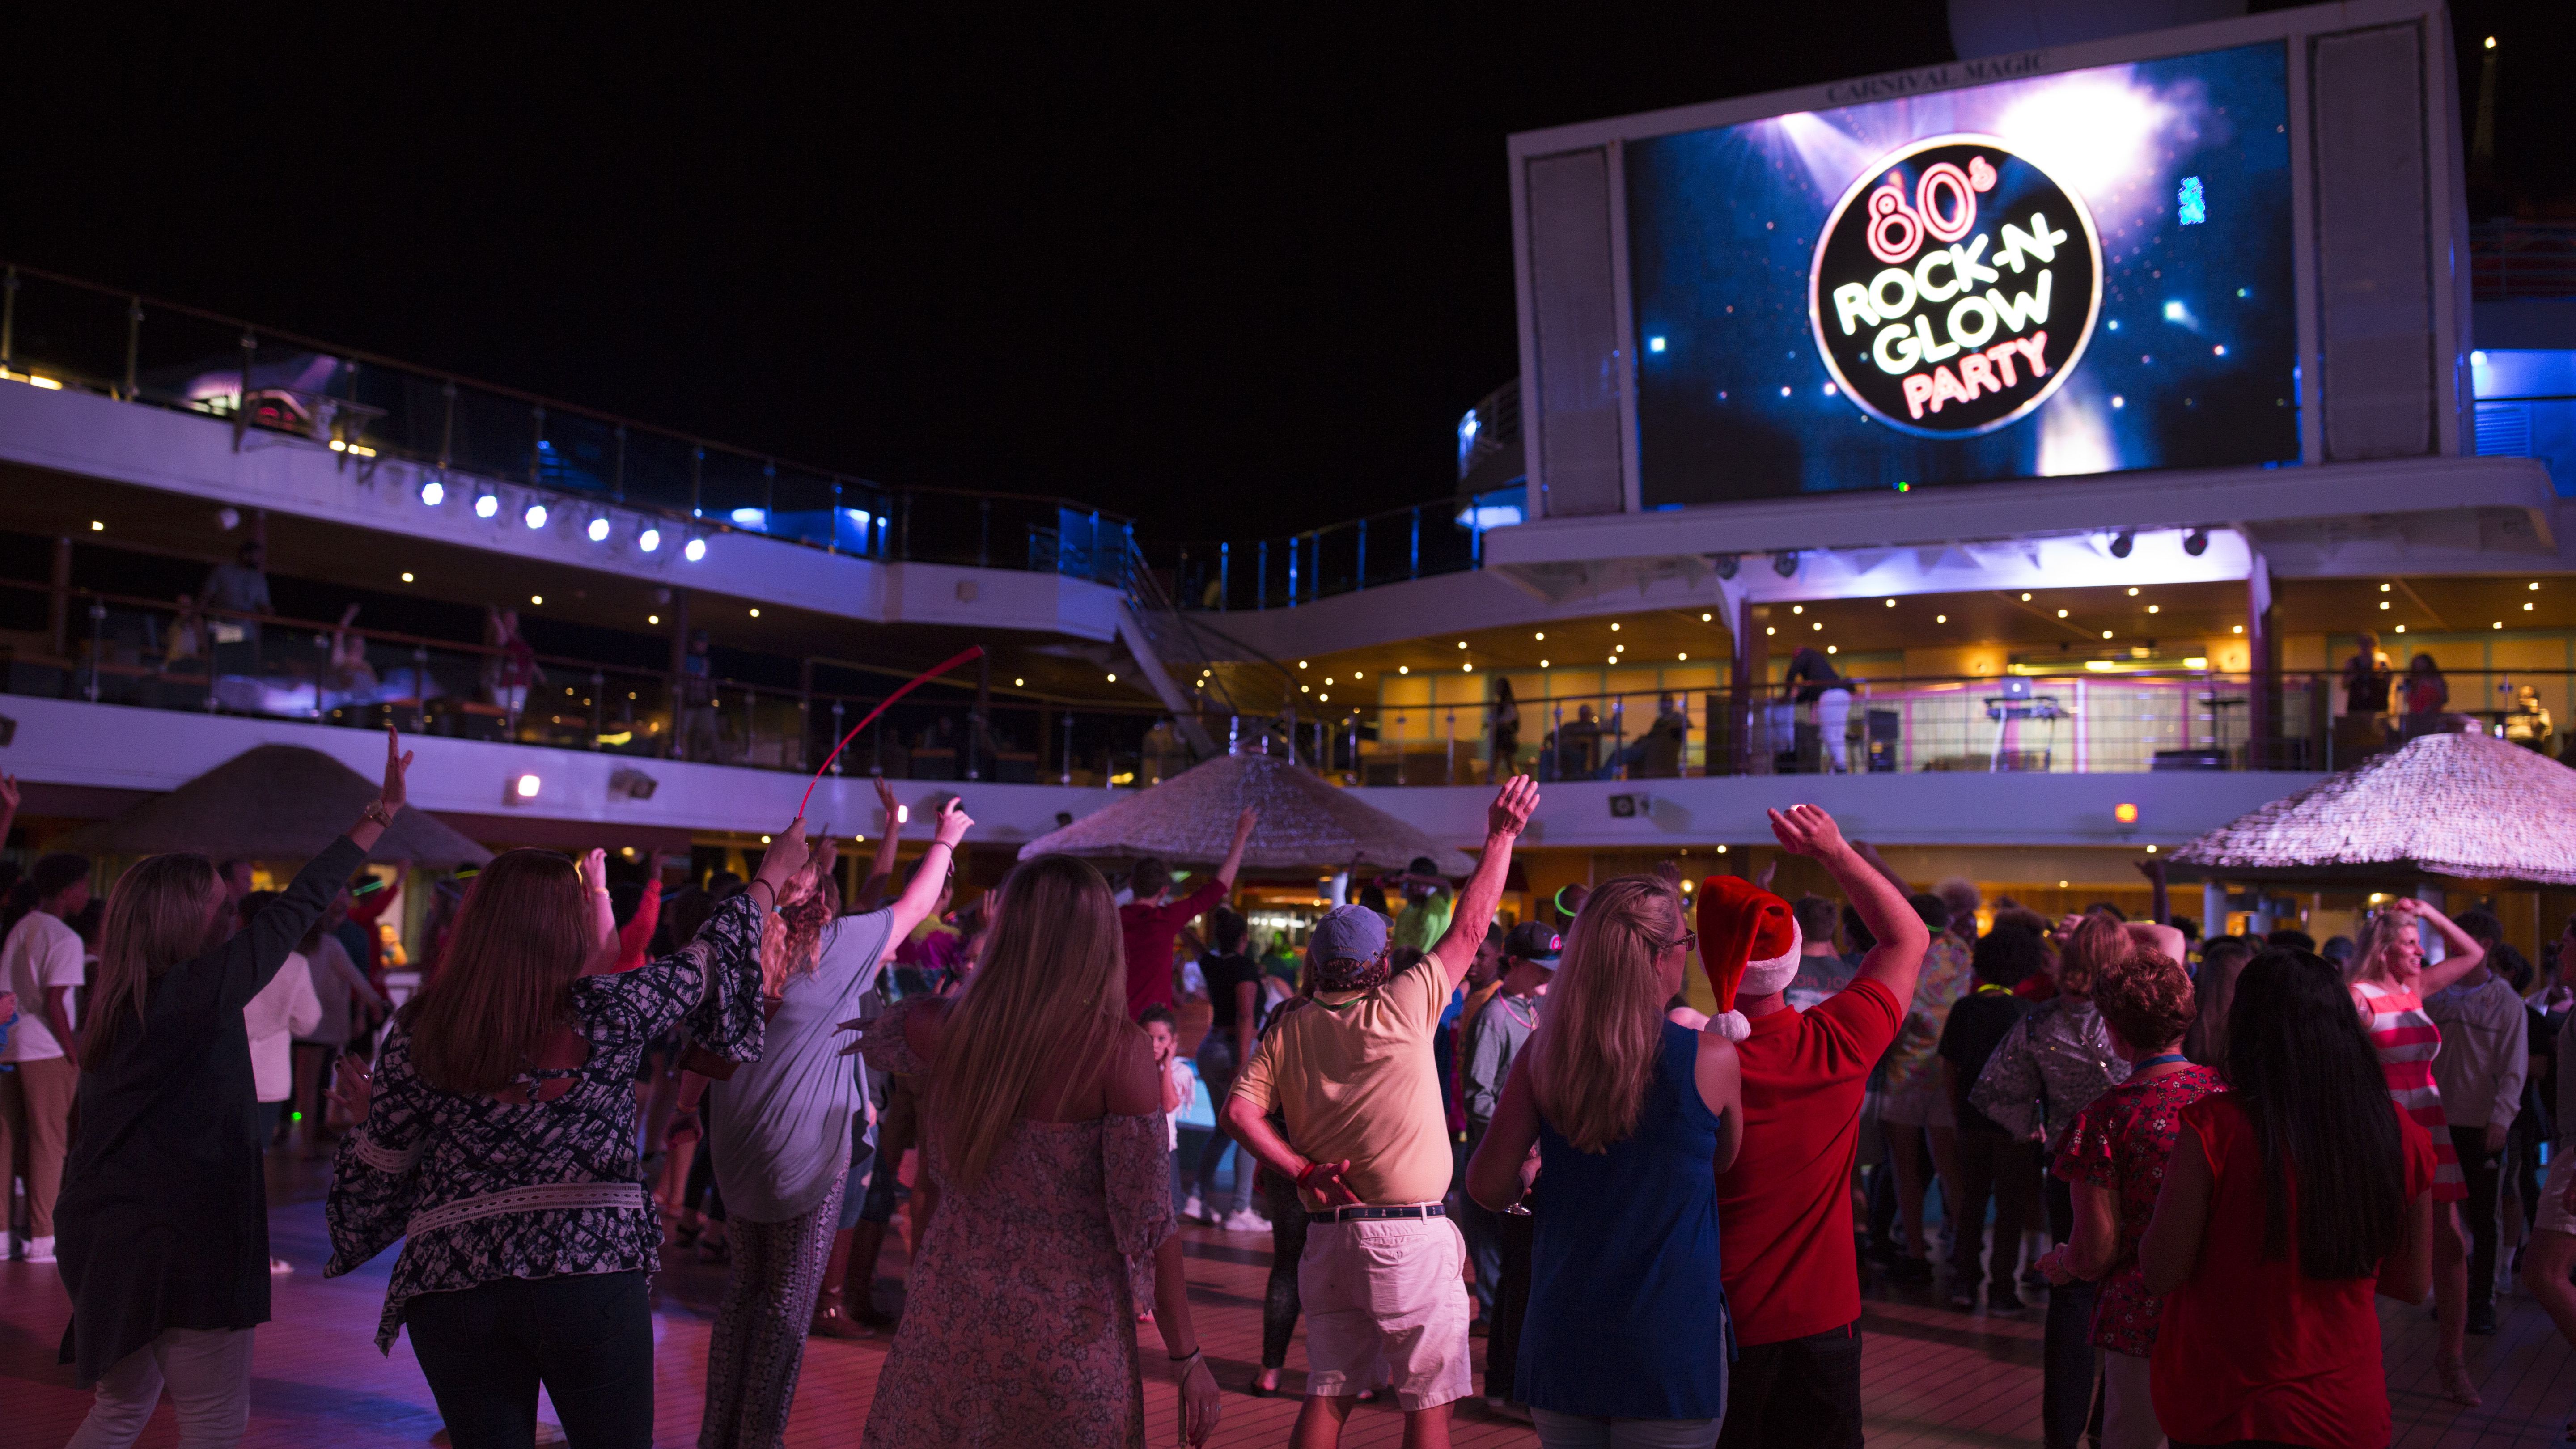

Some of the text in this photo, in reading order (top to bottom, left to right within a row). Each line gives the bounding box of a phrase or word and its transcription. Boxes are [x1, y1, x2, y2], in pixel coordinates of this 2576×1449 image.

[1827, 54, 2044, 102] CARNIVAL MAGIC
[1873, 269, 2052, 374] GLOW
[1902, 330, 2047, 419] PARTY
[1789, 974, 1818, 987] ON
